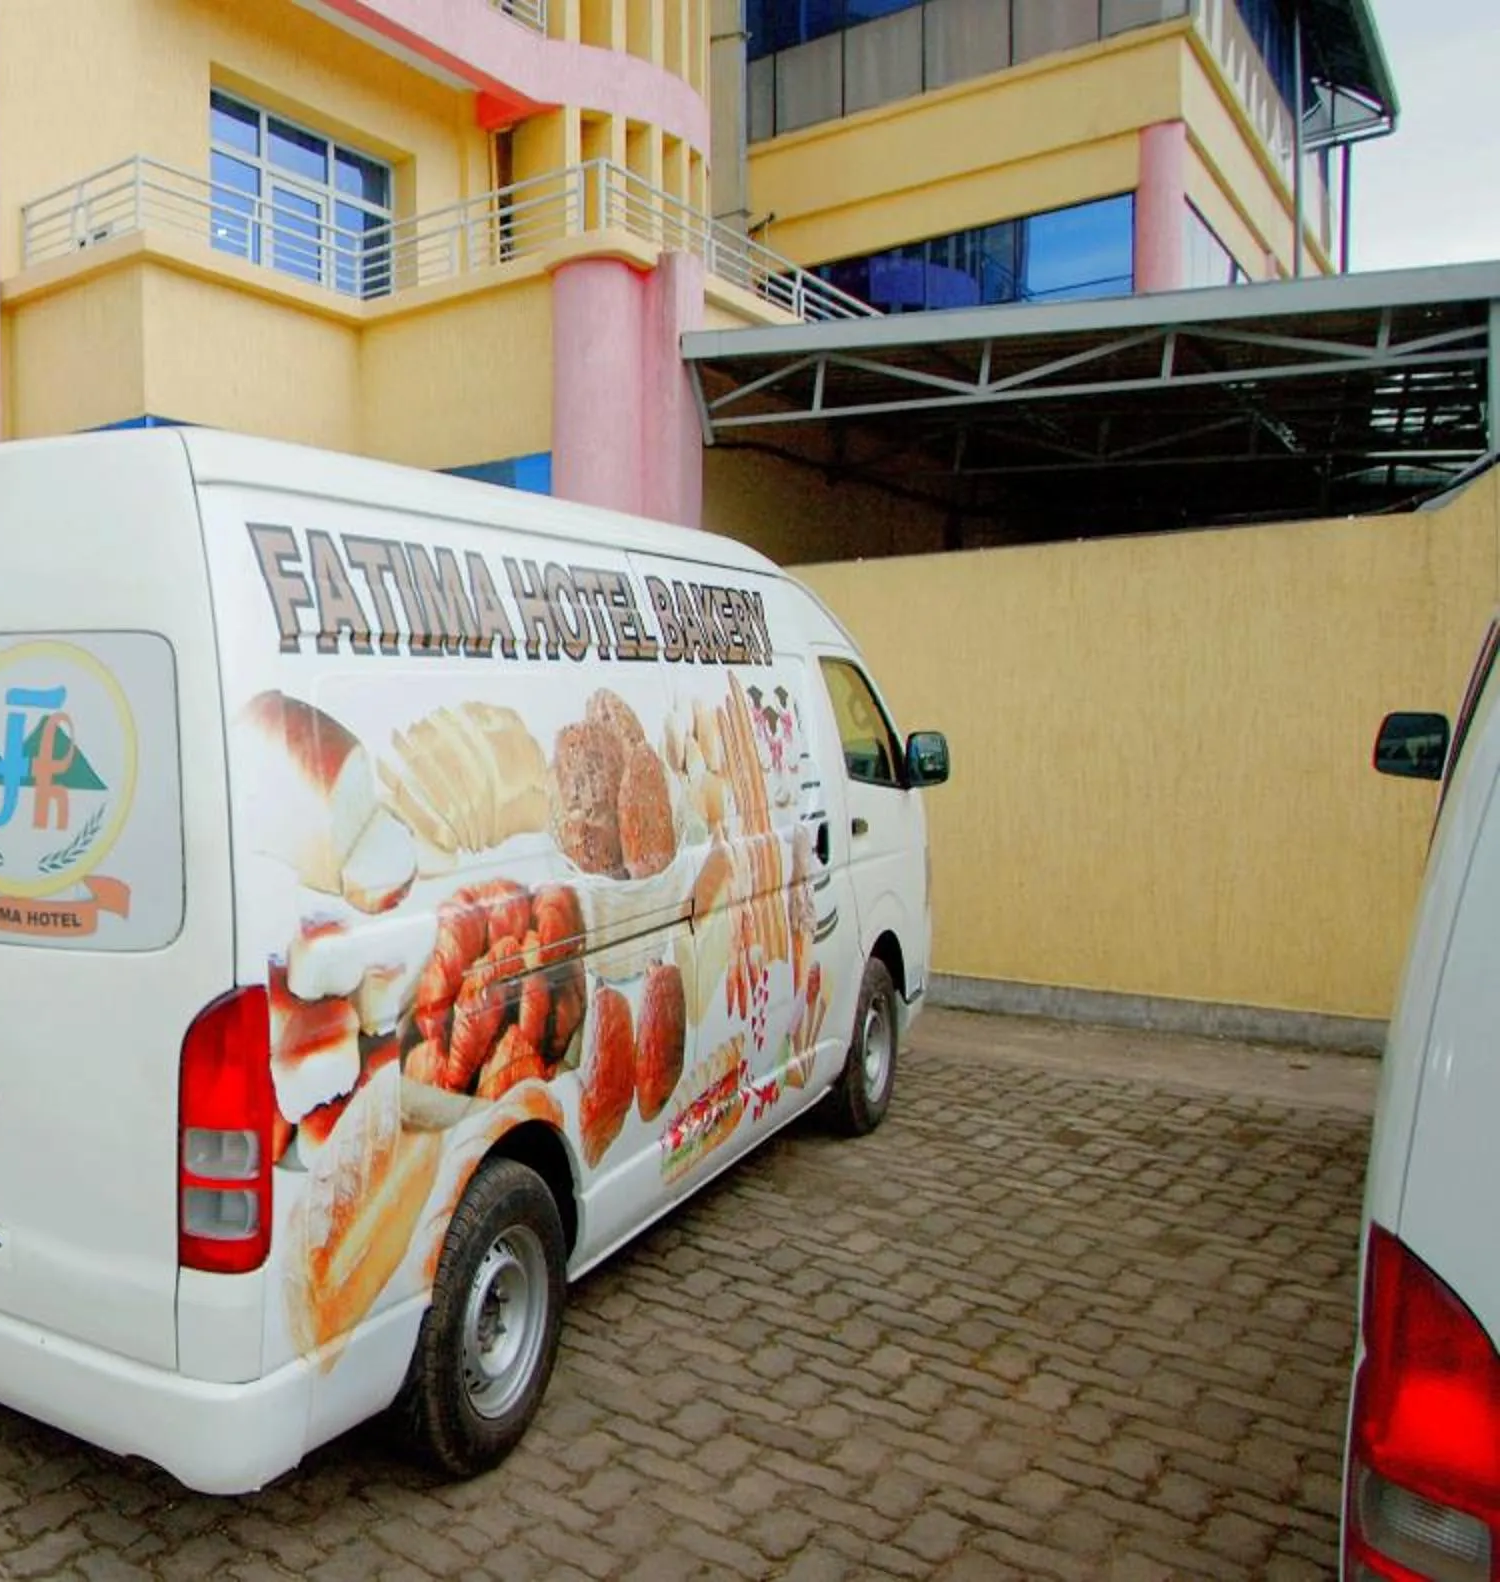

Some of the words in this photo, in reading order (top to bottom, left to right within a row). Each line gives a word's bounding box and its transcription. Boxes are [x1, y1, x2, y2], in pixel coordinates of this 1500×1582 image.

[246, 522, 518, 660] FATIMA
[502, 556, 658, 661] HOTEL
[645, 575, 773, 666] BAKERY
[26, 911, 83, 928] HOTEL
